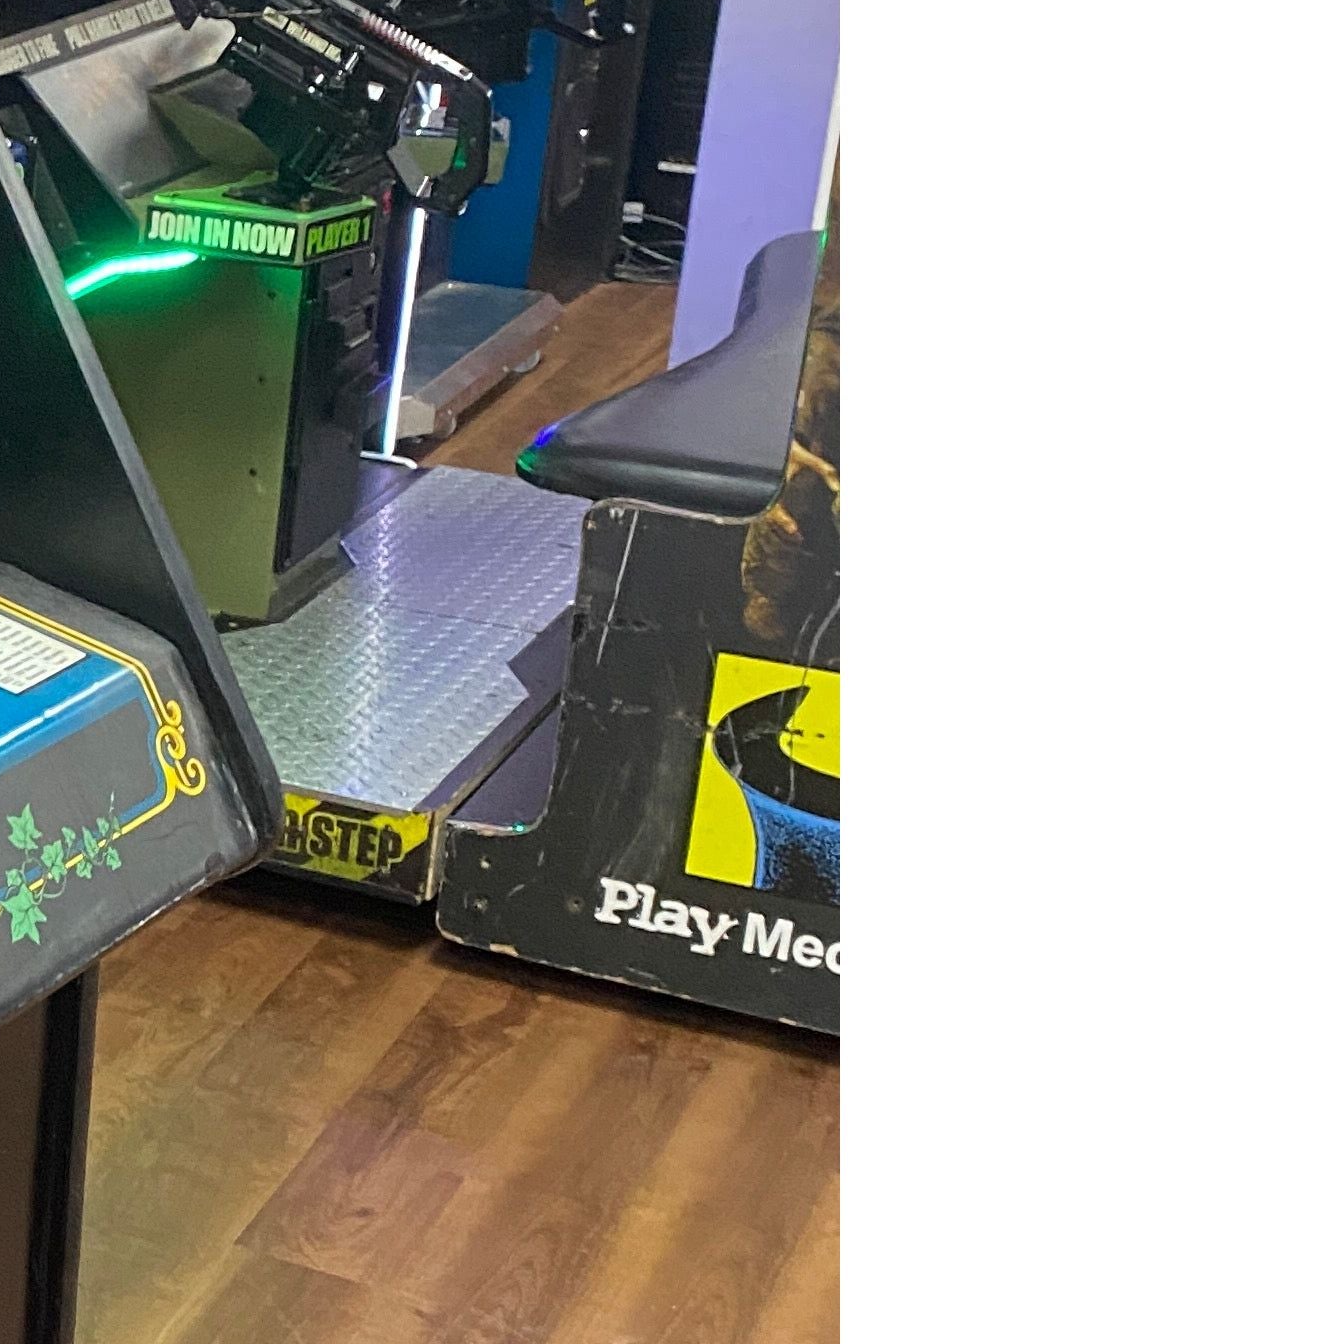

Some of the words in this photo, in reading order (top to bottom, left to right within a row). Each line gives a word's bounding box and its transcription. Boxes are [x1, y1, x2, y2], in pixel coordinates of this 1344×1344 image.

[148, 209, 201, 244] JOIN
[203, 216, 230, 250] IN
[232, 220, 296, 258] NOW
[307, 216, 360, 257] PLAYER
[362, 214, 372, 242] 1
[309, 814, 404, 870] STEP
[594, 876, 740, 957] Play
